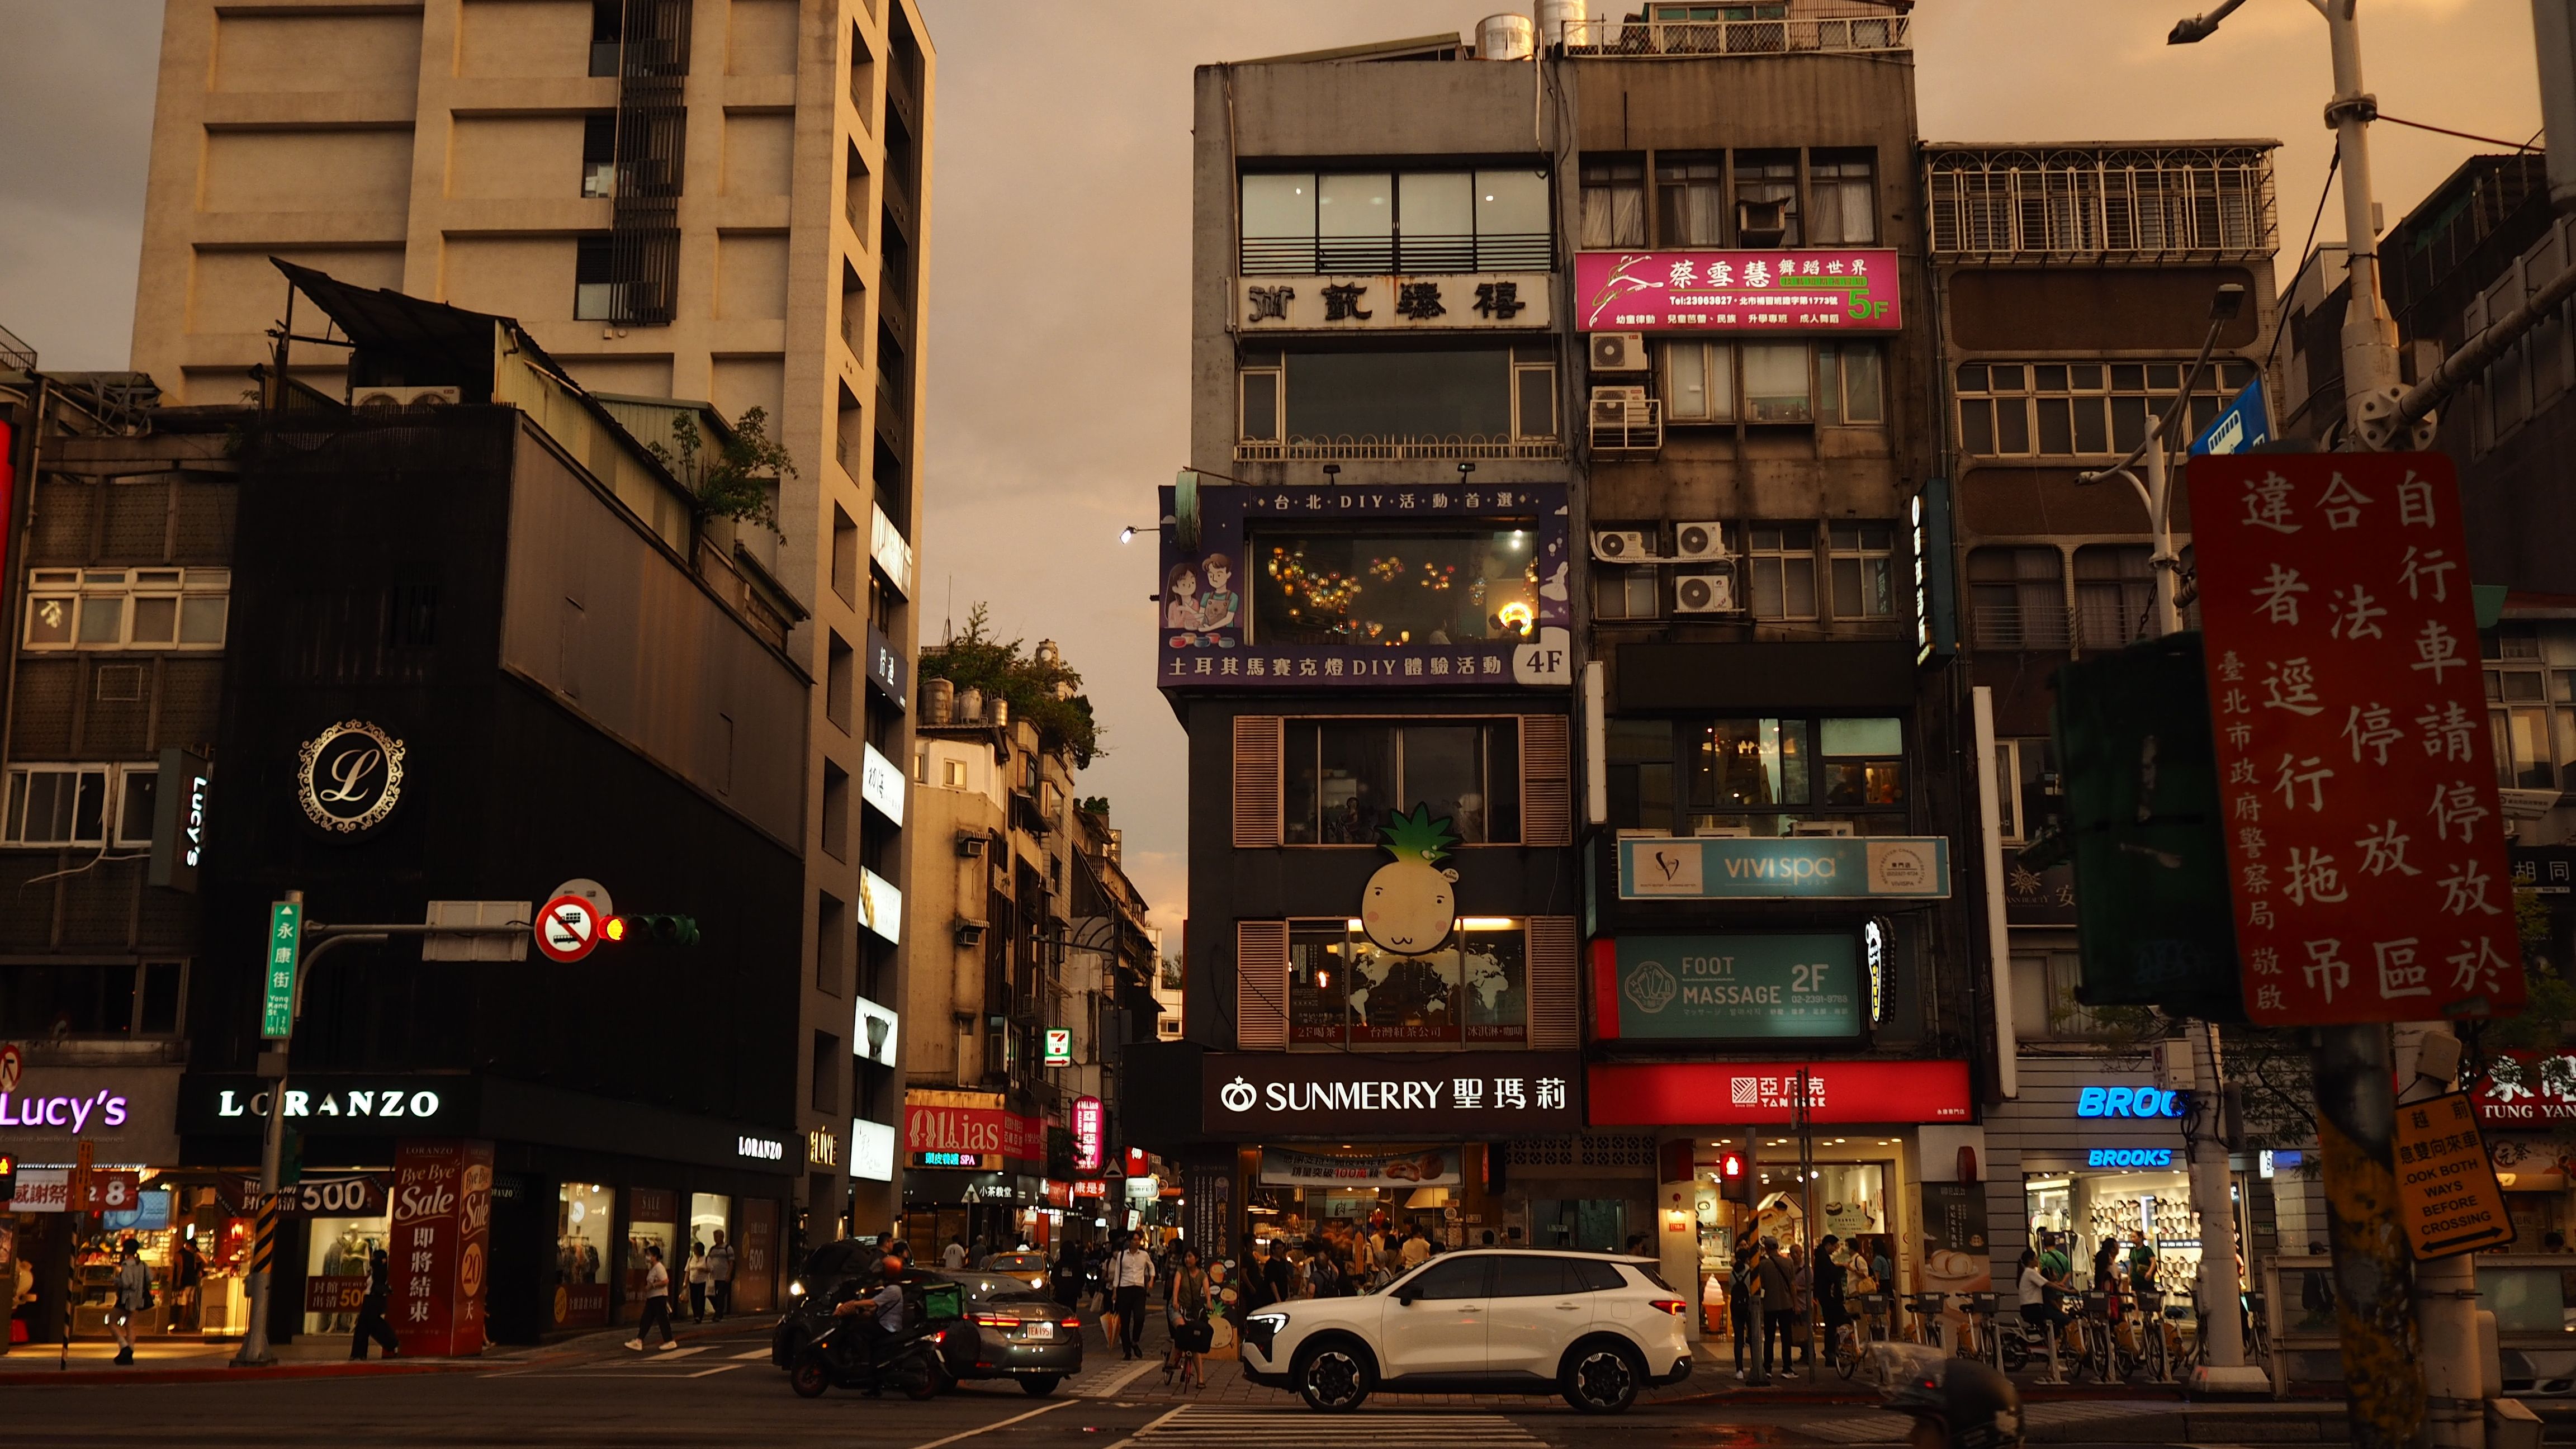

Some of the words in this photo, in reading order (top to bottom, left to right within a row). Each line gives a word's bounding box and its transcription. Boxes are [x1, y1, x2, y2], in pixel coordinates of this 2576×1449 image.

[1669, 259, 1771, 288] 蔡雪慧
[1778, 258, 1867, 276] 舞蹈世界
[1848, 288, 1889, 319] 5F
[1527, 650, 1562, 673] 4F
[2314, 470, 2432, 1001] 合法停放區
[2395, 468, 2511, 994] 自行車請停放於
[2217, 649, 2276, 932] 臺北市政府警察局
[187, 776, 207, 867] Lucy's
[273, 922, 294, 989] 永康街
[1682, 956, 1735, 975] FOOT
[1791, 964, 1830, 992] 2F
[268, 1002, 288, 1011] Kang
[269, 995, 290, 1003] Yong
[1683, 986, 1782, 1005] MASSAGE
[219, 1090, 439, 1117] LORANZO
[1266, 1080, 1445, 1111] SUNMERRY
[1452, 1077, 1566, 1110] 聖瑪莉
[0, 1088, 128, 1135] Lucy's
[2482, 1104, 2534, 1119] TUNG
[405, 1146, 453, 1155] LORANZO
[738, 1136, 782, 1161] LORANZO
[959, 1154, 976, 1166] SPA
[2087, 1148, 2174, 1167] BROOKS
[400, 1167, 427, 1186] Bye
[428, 1163, 456, 1184] Bye
[2404, 1169, 2437, 1186] OOK
[2441, 1158, 2478, 1177] BOTH
[301, 1180, 366, 1211] 500
[394, 1184, 454, 1221] Sale
[2424, 1181, 2463, 1199] WAYS
[461, 1192, 489, 1235] Sale
[2422, 1195, 2478, 1218] BEFORE
[2421, 1210, 2492, 1236] CROSSING
[464, 1253, 482, 1285] 20
[749, 1249, 764, 1271] 500
[408, 1227, 435, 1323] 即將結束
[465, 1300, 475, 1322] 天
